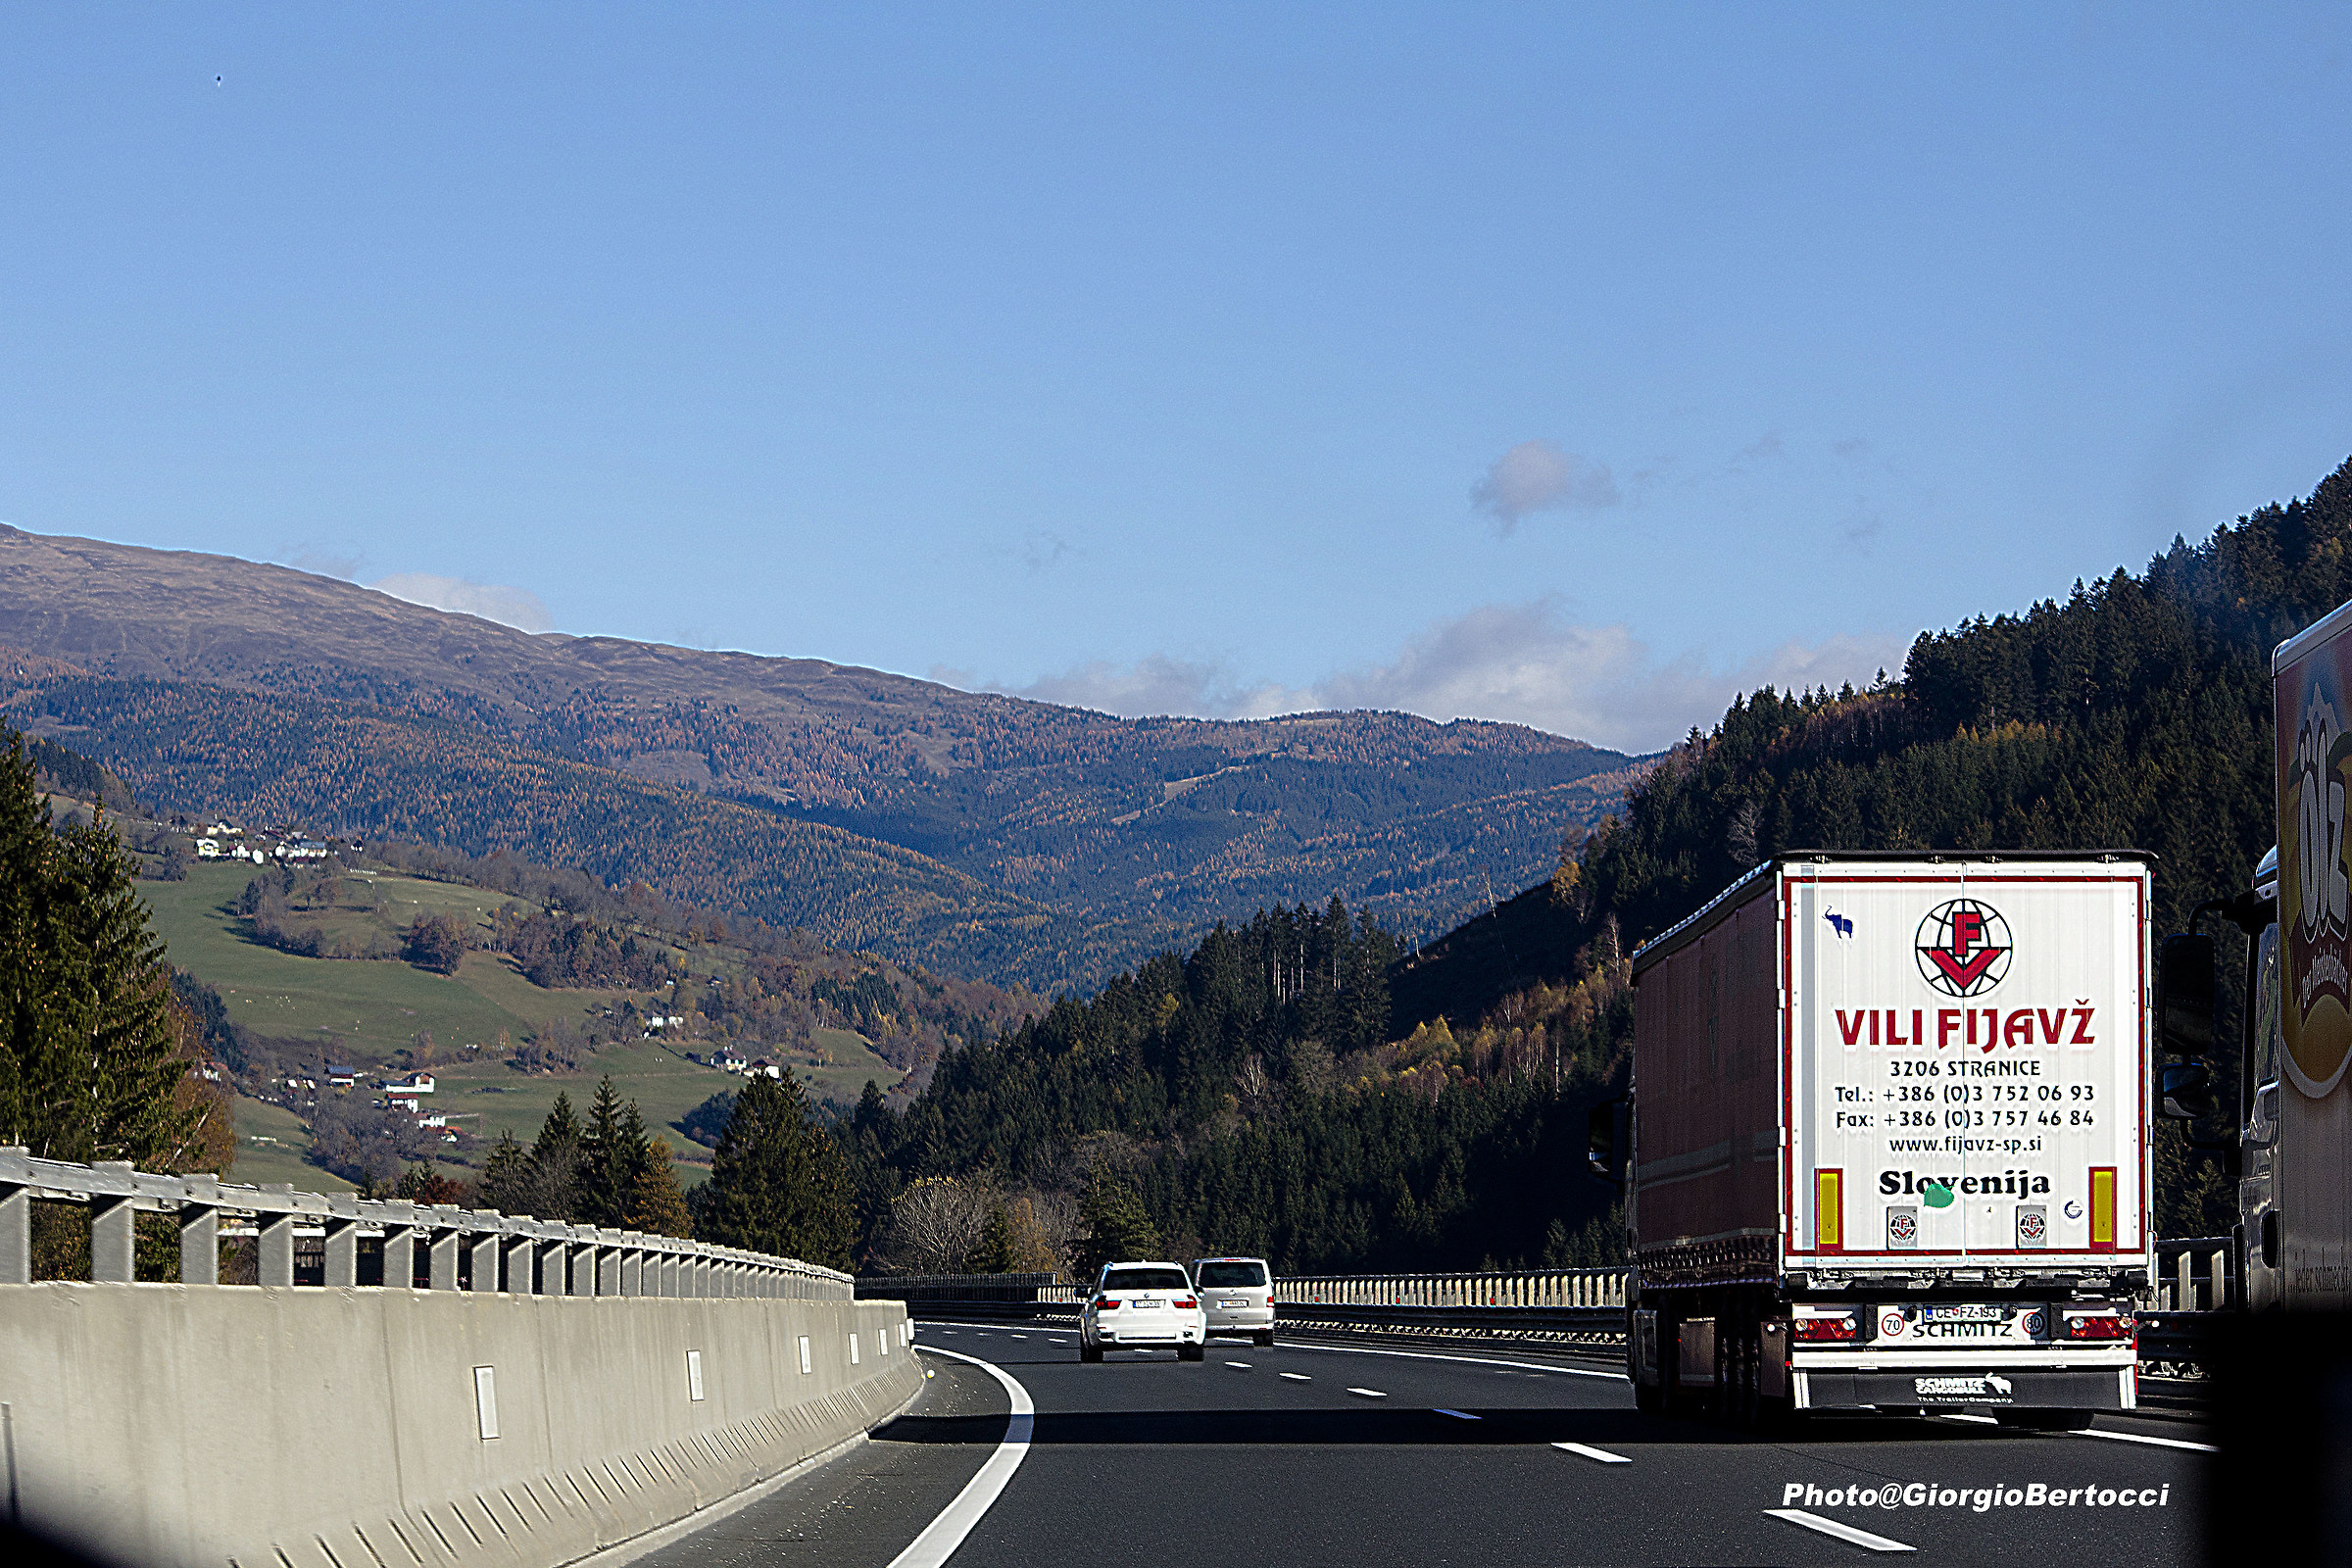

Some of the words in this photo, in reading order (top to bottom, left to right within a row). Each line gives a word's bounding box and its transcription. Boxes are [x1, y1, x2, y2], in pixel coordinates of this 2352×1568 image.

[1836, 1009, 1922, 1045] VILI
[1938, 999, 2095, 1054] FIJAVŽ
[1891, 1061, 1939, 1076] 3206
[1948, 1060, 2040, 1077] STRANICE
[1836, 1087, 1873, 1102] Tel.:
[1884, 1086, 1935, 1101] +386
[1944, 1085, 1982, 1103] (0)3
[1993, 1086, 2028, 1101] 752
[2038, 1086, 2061, 1101] 06
[2071, 1086, 2093, 1101] 93
[1837, 1112, 1873, 1128] Fax:
[1885, 1111, 1936, 1126] +386
[1945, 1109, 1983, 1129] (0)3
[1993, 1111, 2028, 1126] 757
[2038, 1110, 2061, 1125] 46
[2071, 1110, 2093, 1125] 84
[1889, 1136, 2040, 1154] www.fijavz-sp.si
[1880, 1170, 2050, 1200] Slovenija
[1936, 1306, 1952, 1319] CE
[1960, 1305, 1997, 1319] FZ-193
[1886, 1320, 1900, 1331] 70
[1912, 1323, 2013, 1338] SCHMITZ
[1915, 1378, 1985, 1388] SCHMITZ
